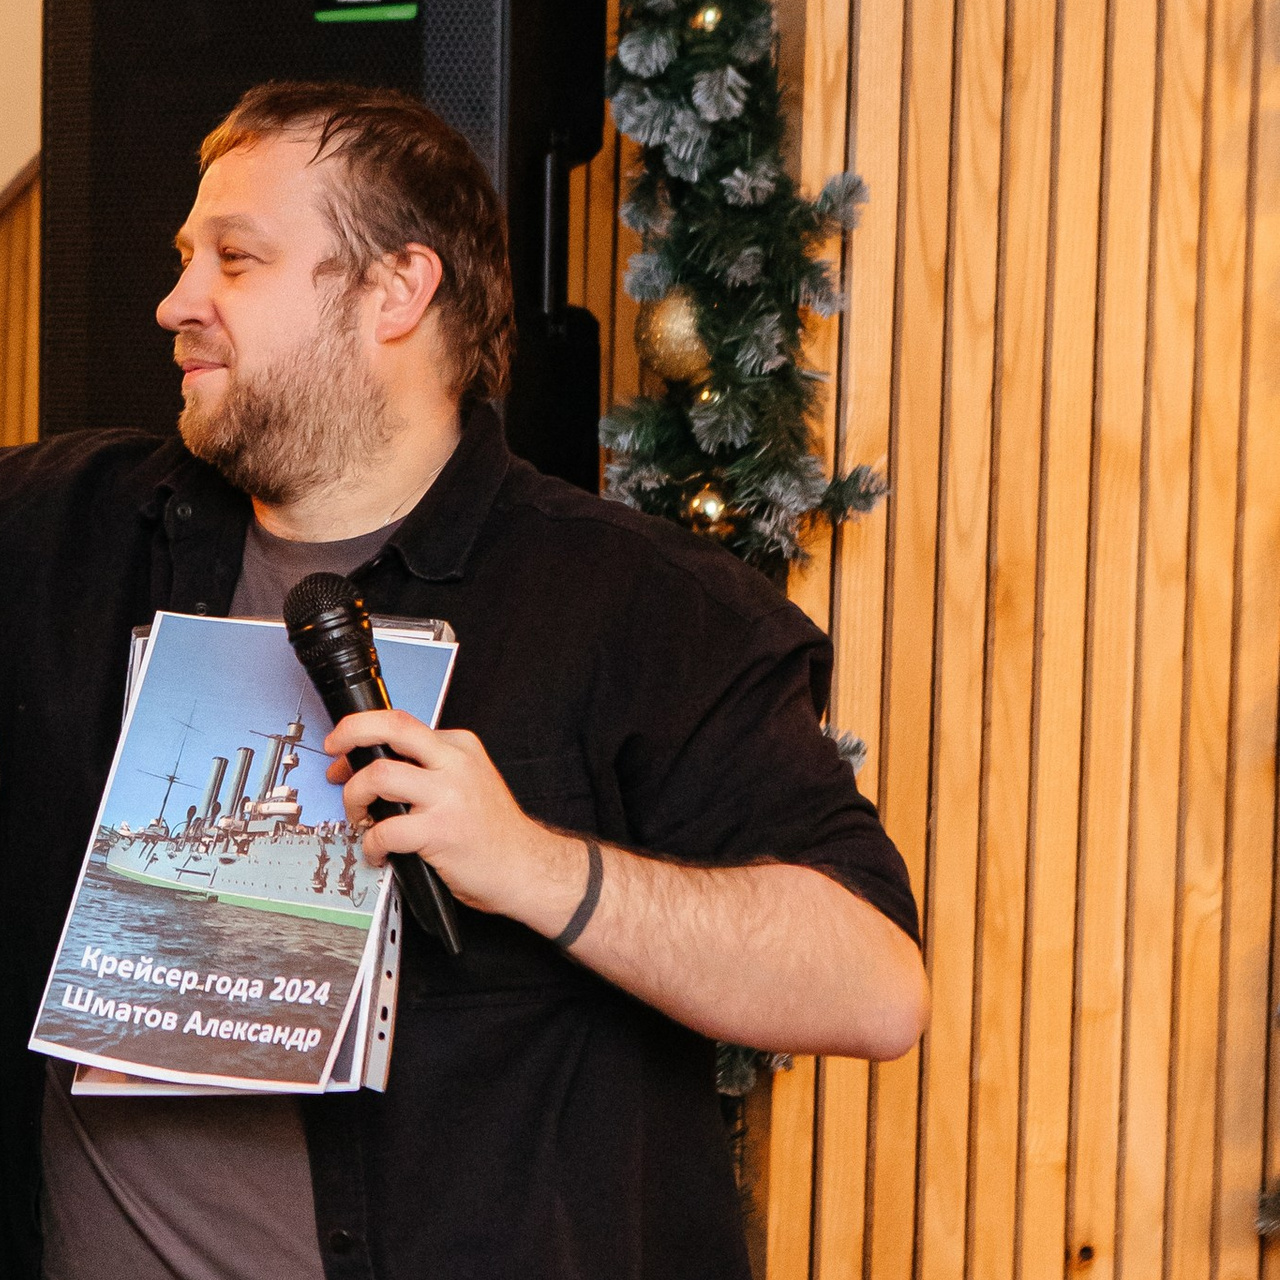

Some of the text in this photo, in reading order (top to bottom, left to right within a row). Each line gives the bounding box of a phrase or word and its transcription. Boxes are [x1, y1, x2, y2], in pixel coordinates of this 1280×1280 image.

[80, 945, 331, 1005] Крейсер года 2024
[61, 984, 322, 1053] Шматов Александр
